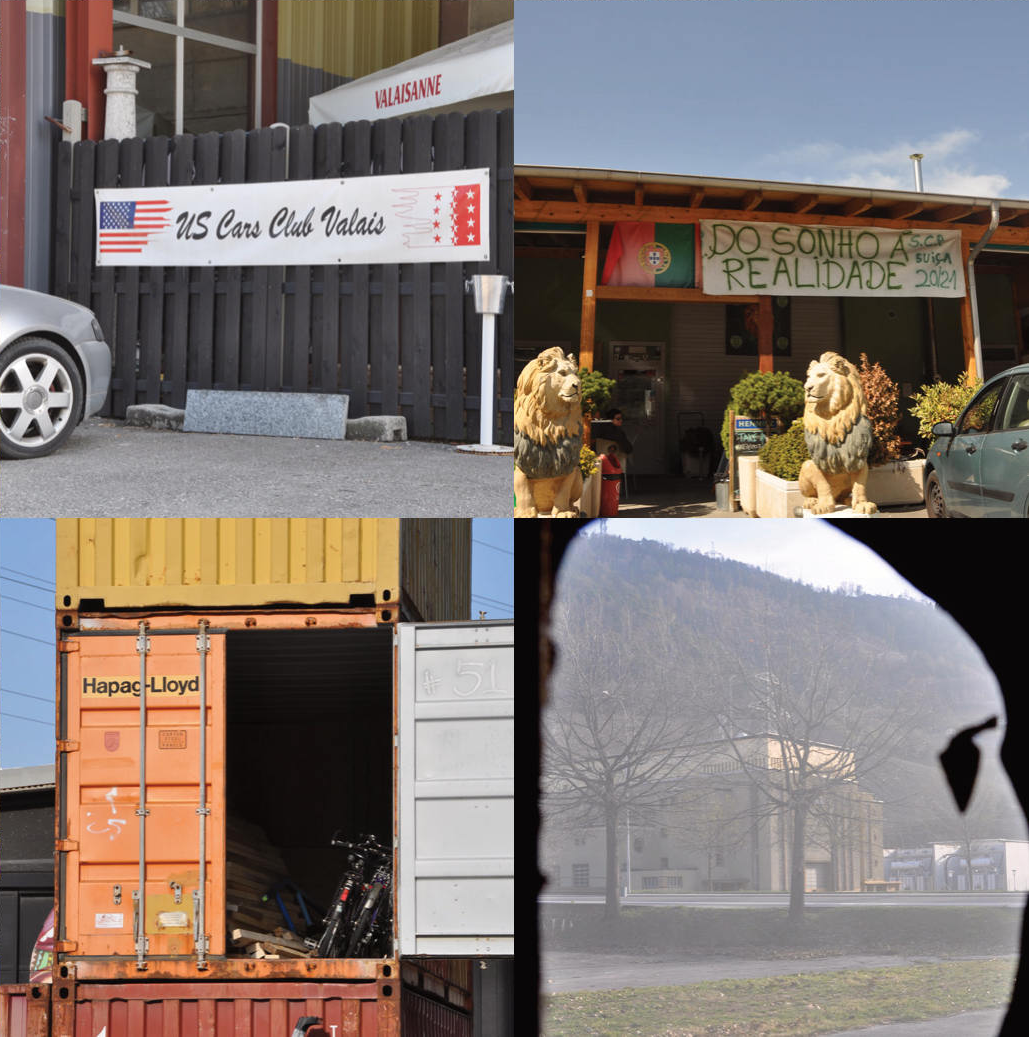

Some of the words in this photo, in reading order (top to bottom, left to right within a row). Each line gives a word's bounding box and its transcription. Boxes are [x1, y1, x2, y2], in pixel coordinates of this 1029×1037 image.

[374, 74, 442, 110] VALAISANNE
[175, 211, 209, 240] US
[216, 209, 263, 240] Cars
[269, 208, 314, 239] Club
[320, 206, 386, 238] Valais
[709, 224, 761, 259] DO
[772, 227, 880, 259] SONHO
[723, 256, 906, 291] REALIDADE
[915, 269, 957, 291] 20/21
[82, 676, 200, 697] Hapag-Lloyd
[453, 659, 507, 698] 51
